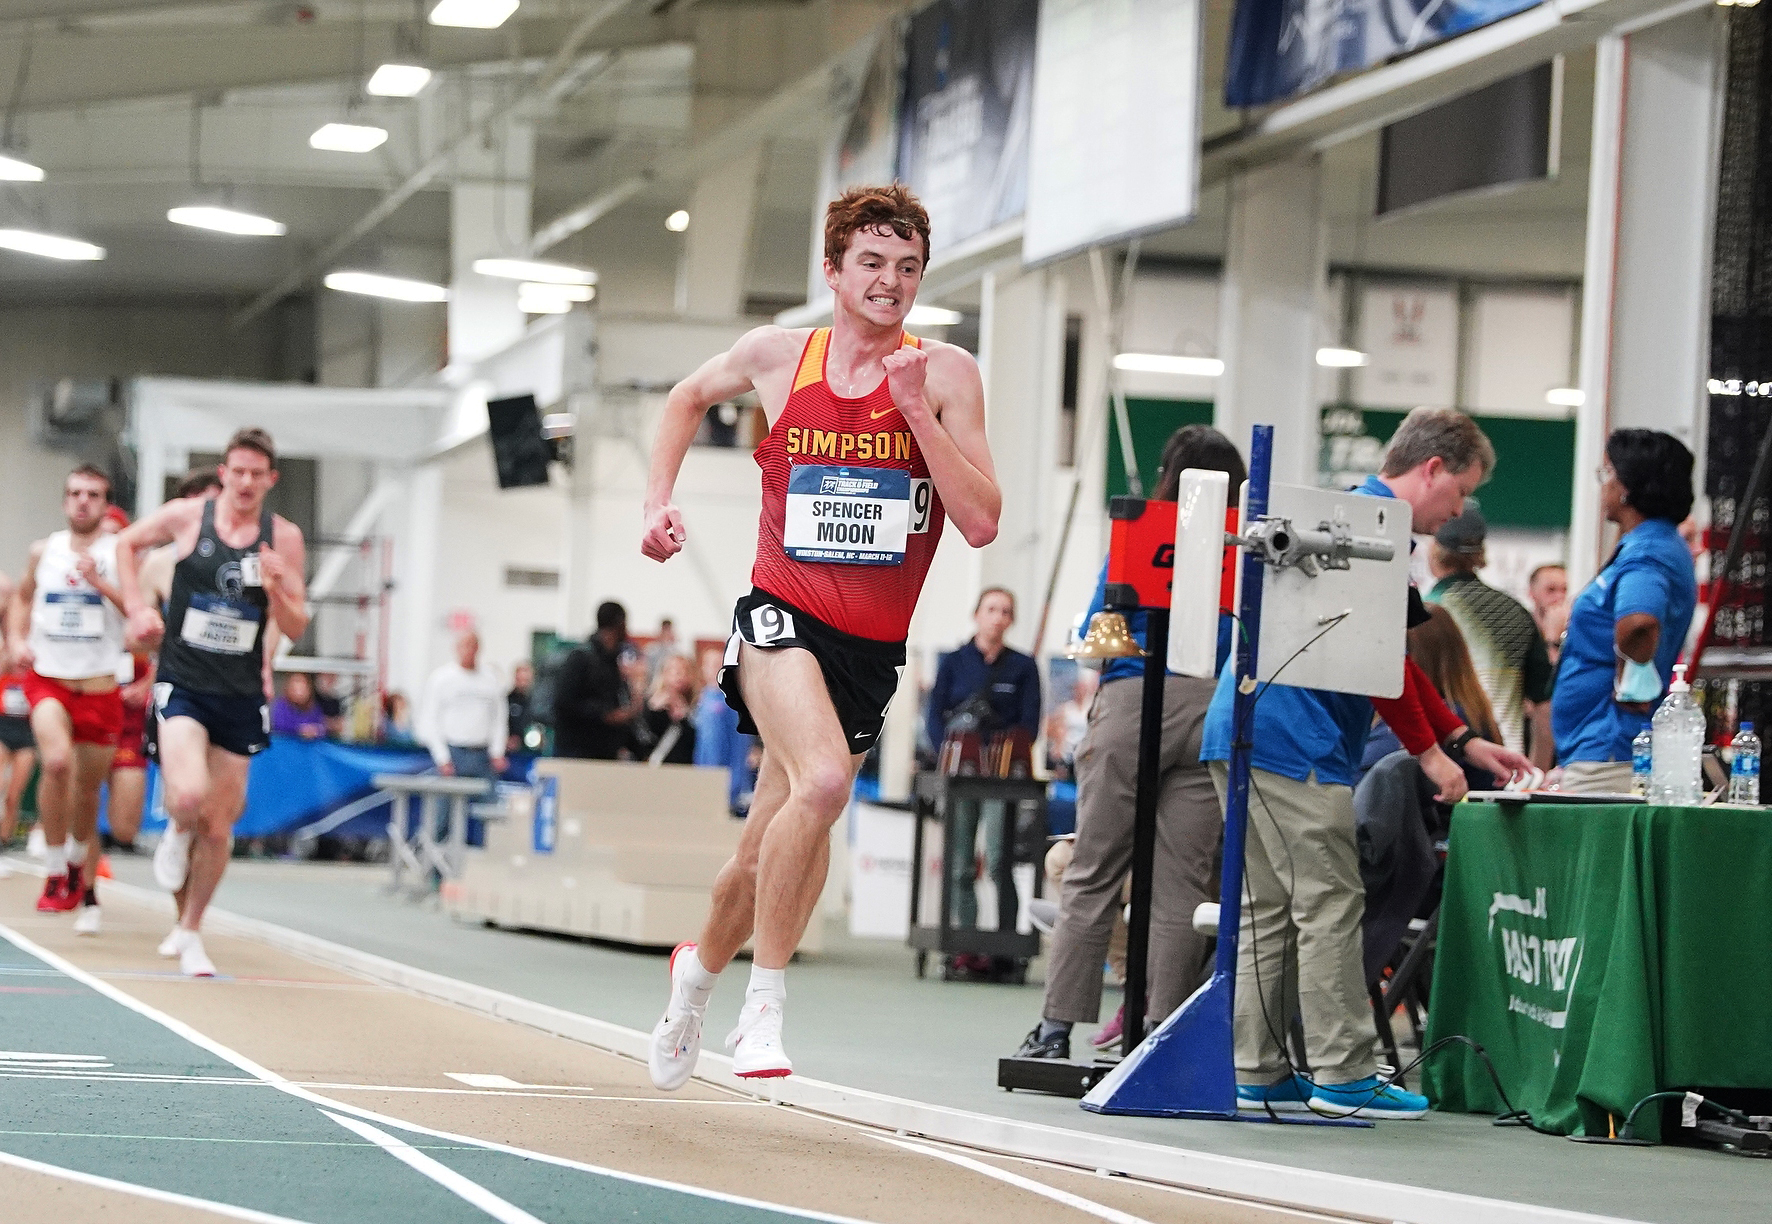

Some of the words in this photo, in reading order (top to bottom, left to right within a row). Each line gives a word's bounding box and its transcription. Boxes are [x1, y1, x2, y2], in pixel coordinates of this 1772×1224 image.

[787, 427, 911, 461] SIMPSON
[838, 480, 857, 488] TRACK
[812, 501, 883, 520] SPENCER
[913, 481, 930, 532] 9
[817, 522, 875, 544] MOON
[760, 606, 785, 640] 9
